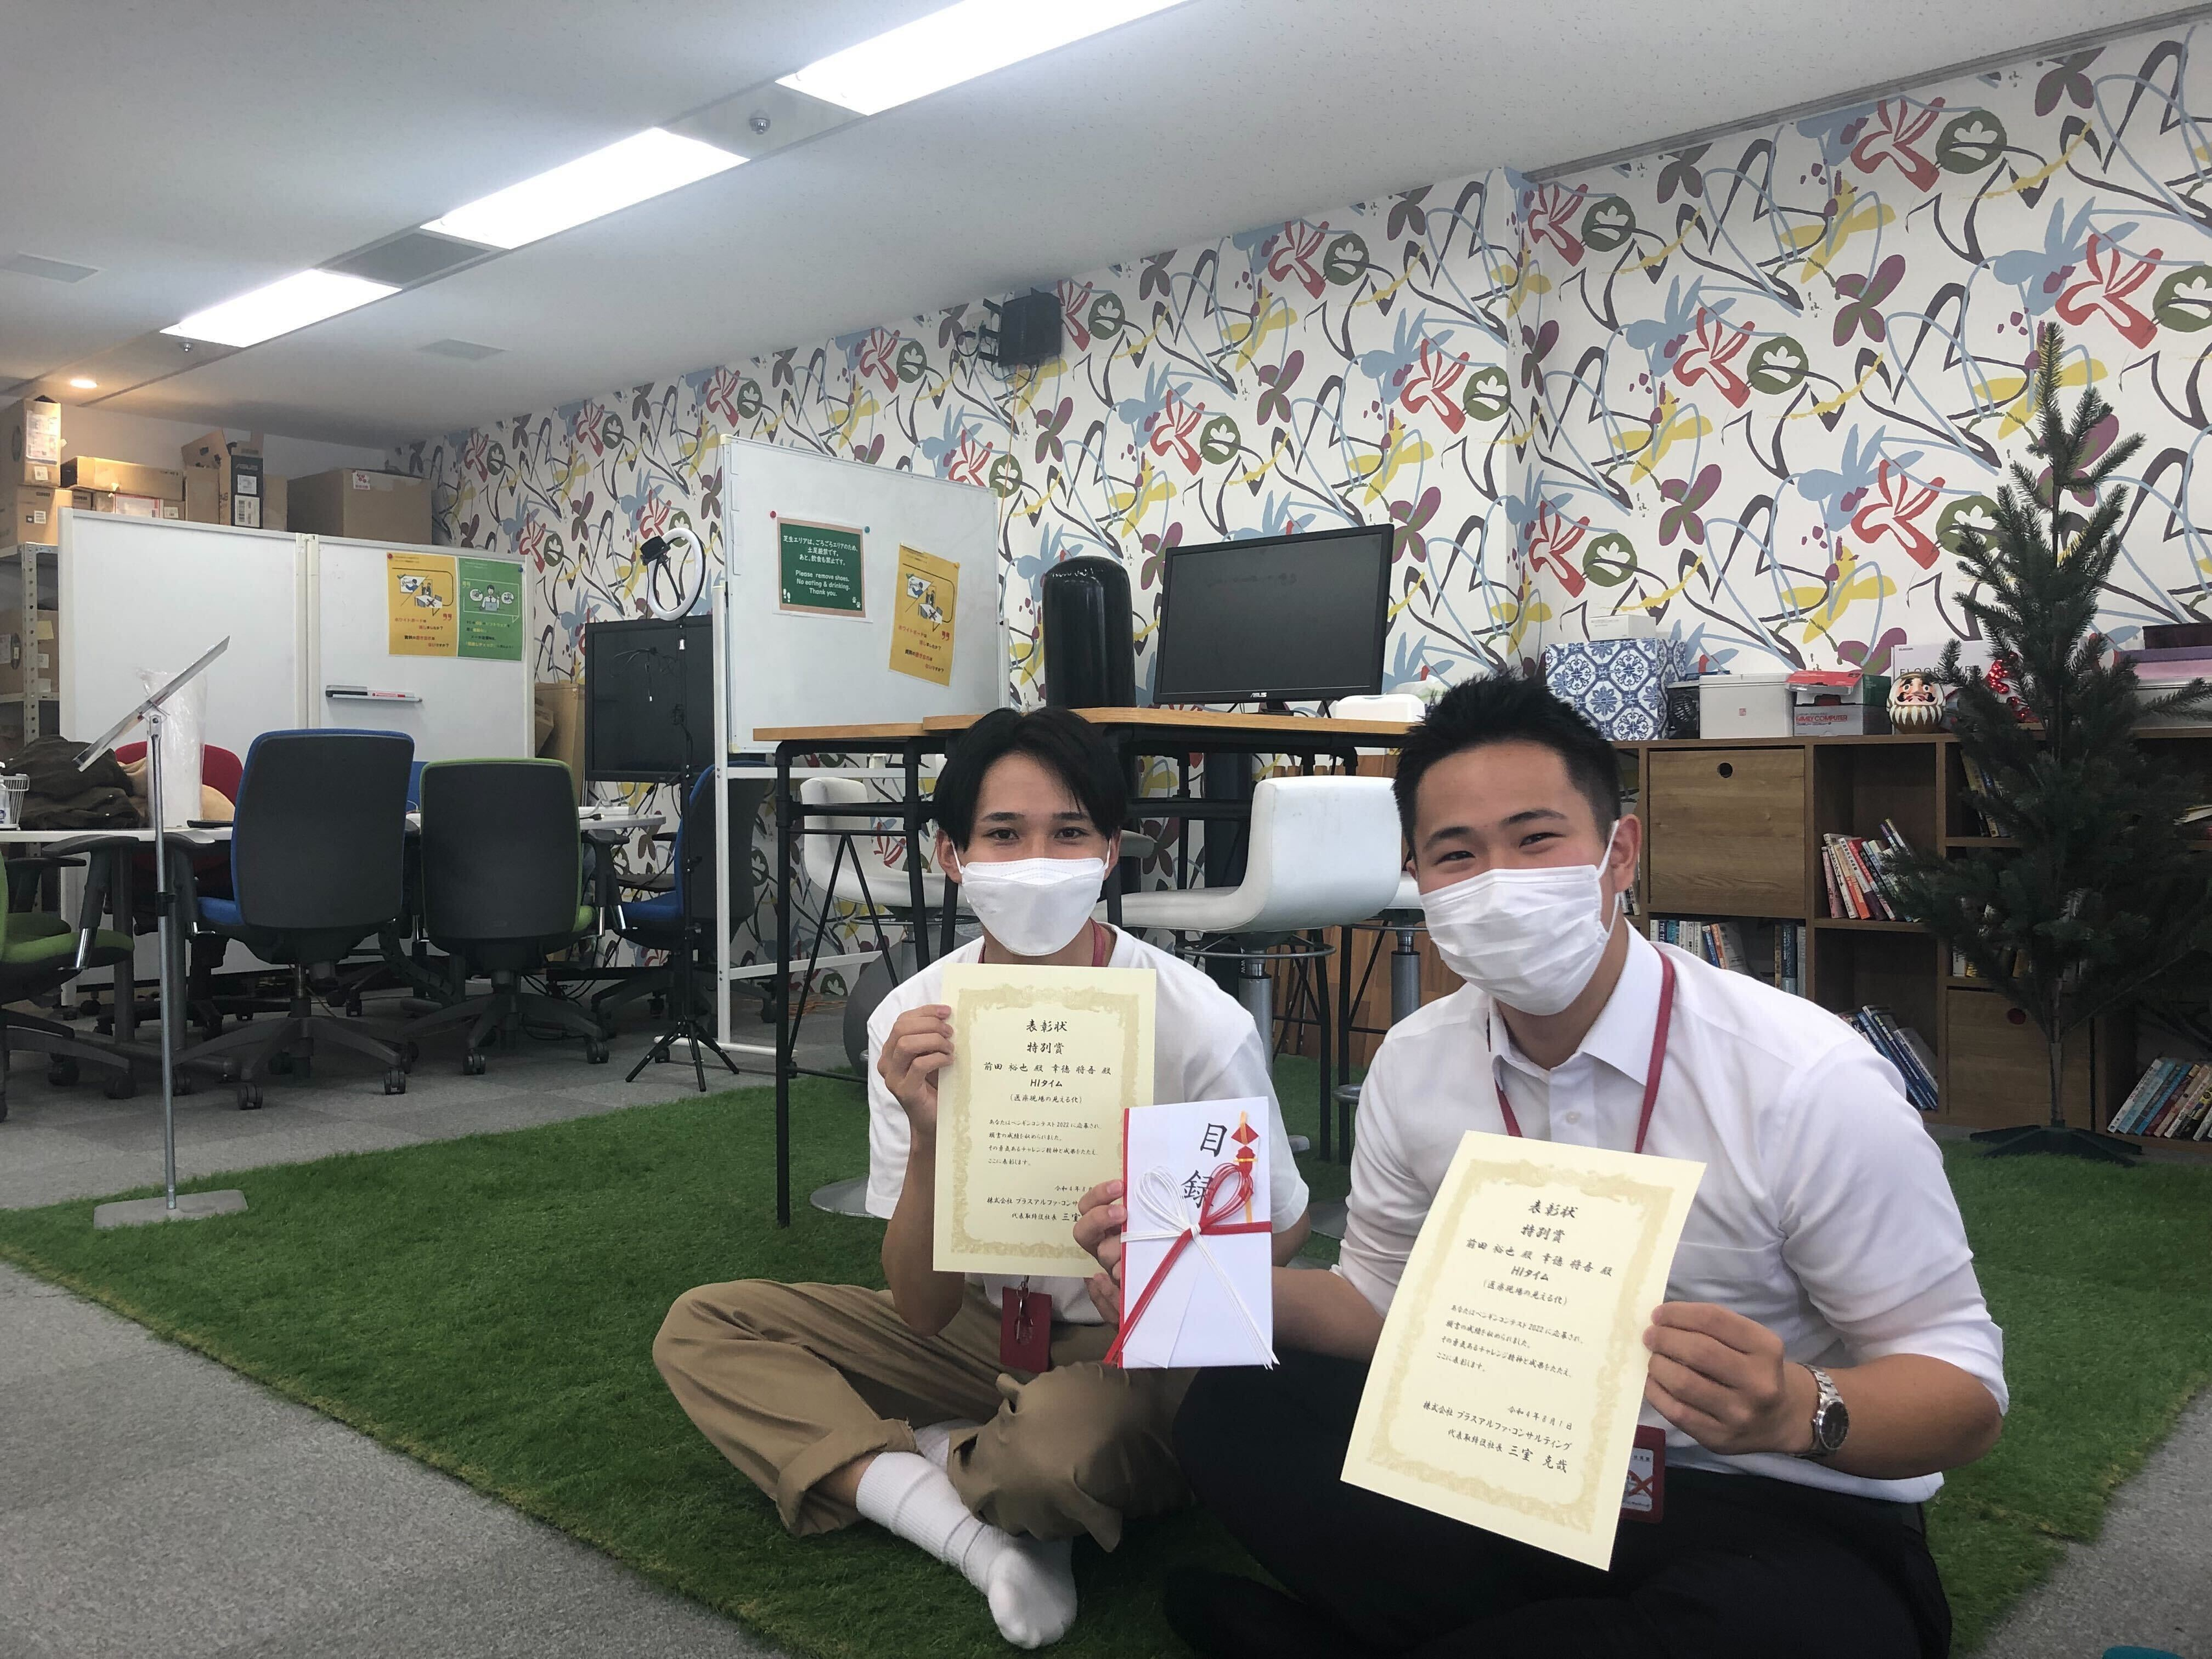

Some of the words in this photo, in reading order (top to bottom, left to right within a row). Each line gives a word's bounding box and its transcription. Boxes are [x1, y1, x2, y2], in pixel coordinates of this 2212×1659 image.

[783, 535, 858, 551] 芝生エリアは、ごろごろエリアのため、
[808, 547, 839, 557] 土足厳禁です。
[799, 554, 845, 566] あと、飲食も禁止です。
[829, 582, 850, 591] drinking.
[1026, 1019, 1067, 1032] 表彰状
[1027, 1041, 1064, 1055] 特別賞
[983, 1062, 1003, 1071] 前田
[1008, 1063, 1029, 1072] 裕也
[1076, 1065, 1096, 1074] 将吾
[1101, 1067, 1112, 1075] 殿
[1030, 1078, 1063, 1088] HIタイム
[986, 1196, 1012, 1205] 株式会社
[1528, 1200, 1578, 1218] 表彰状
[1520, 1224, 1566, 1244] 特別賞
[1466, 1238, 1488, 1249] 前田
[1493, 1244, 1515, 1257] 裕也
[1520, 1250, 1533, 1260] 殿
[1570, 1259, 1594, 1273] 将吾
[1600, 1266, 1613, 1277] 殿
[1511, 1266, 1549, 1281] HIタイム
[1423, 1400, 1453, 1417] 株式会社
[1457, 1411, 1572, 1450] プラスアルファ・コンサルティング
[1448, 1428, 1503, 1452] 代表取締役社長
[1508, 1445, 1533, 1462] 三室
[1543, 1454, 1568, 1474] 克哉
